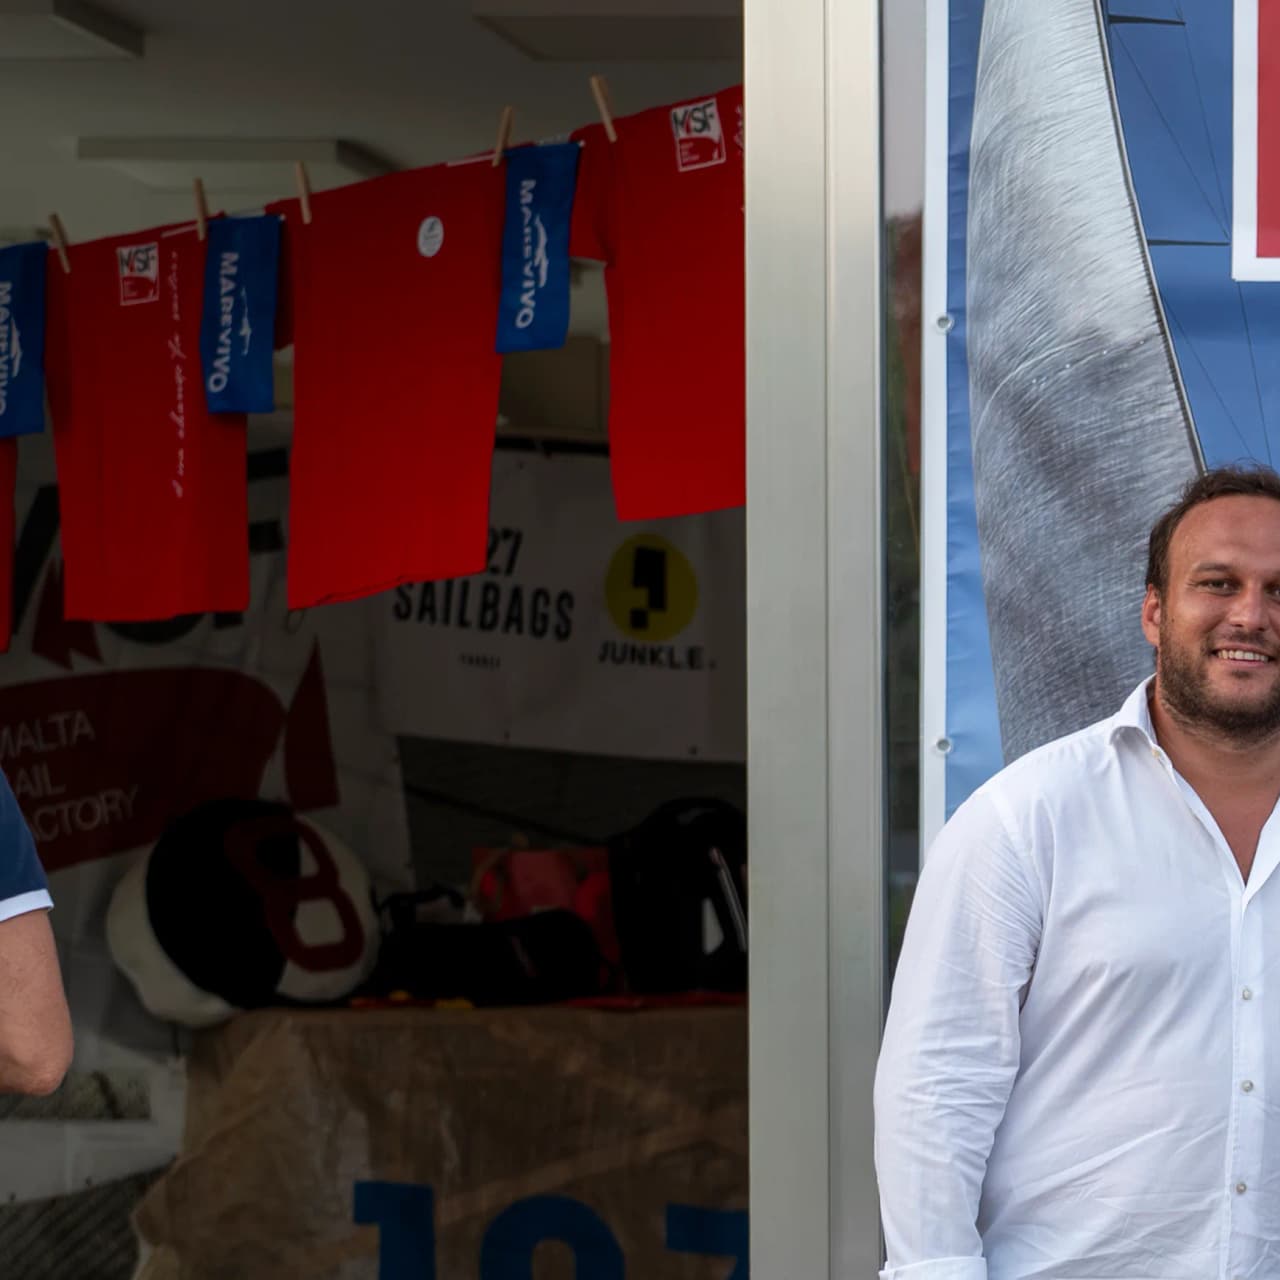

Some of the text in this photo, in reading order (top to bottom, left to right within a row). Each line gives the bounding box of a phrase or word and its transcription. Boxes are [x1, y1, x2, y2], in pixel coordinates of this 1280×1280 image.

[208, 251, 240, 393] MAREVIVO
[393, 579, 575, 643] SAILBAGS
[16, 760, 67, 801] AIL
[31, 784, 140, 845] CTORY
